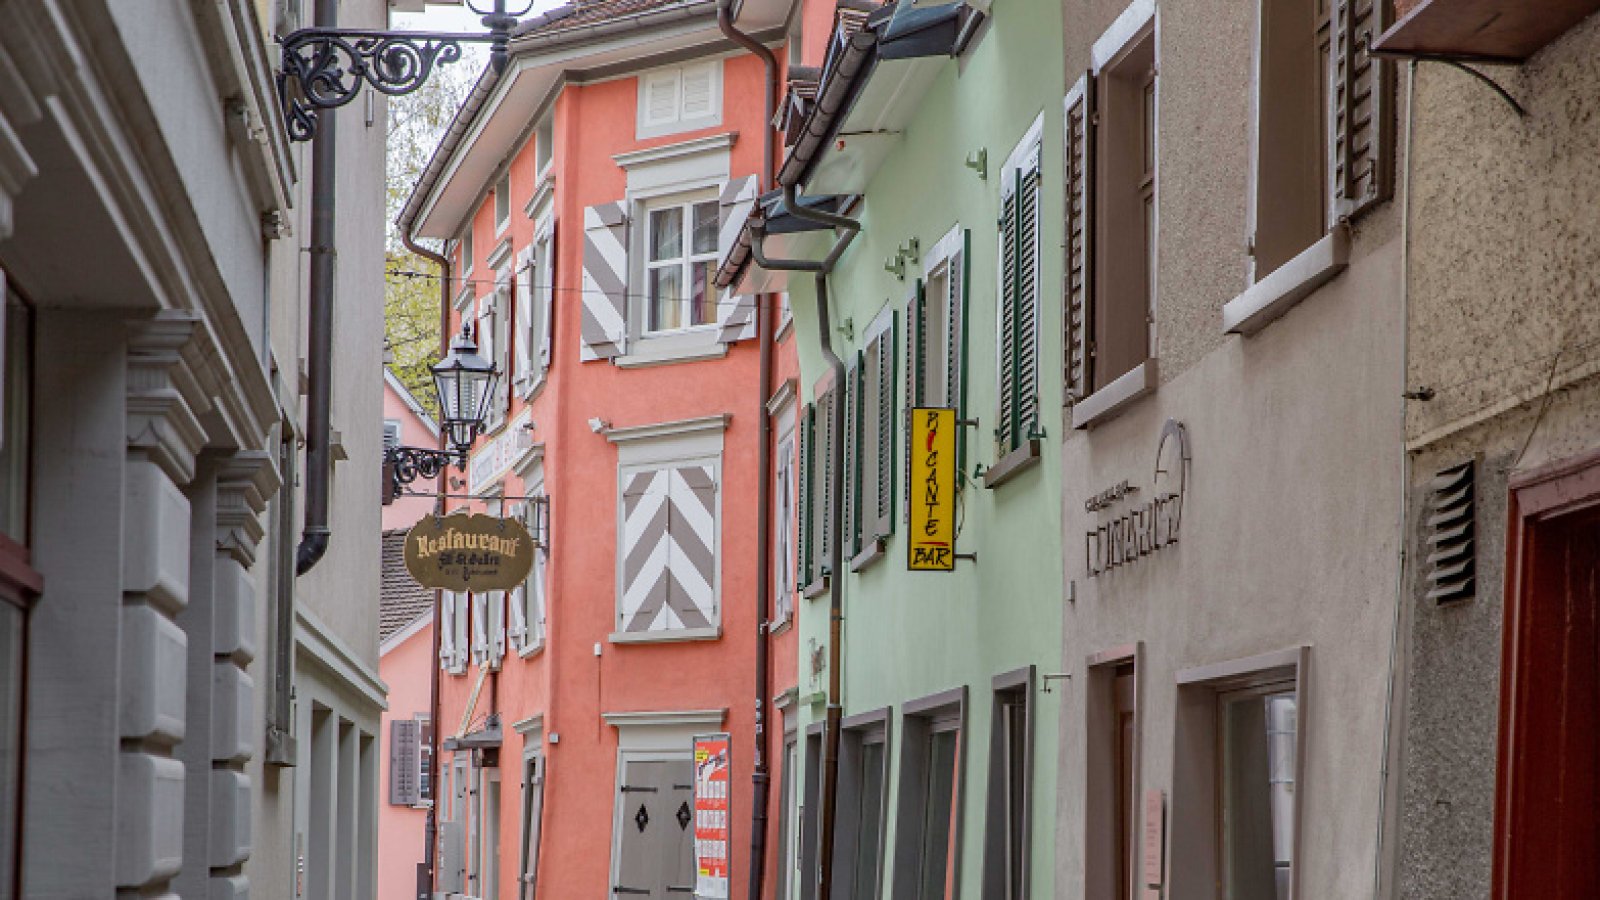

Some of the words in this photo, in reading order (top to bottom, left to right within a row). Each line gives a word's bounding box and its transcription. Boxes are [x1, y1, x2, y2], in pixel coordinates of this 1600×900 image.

[925, 411, 939, 536] PICANTE
[417, 527, 520, 559] Restaurant
[912, 547, 951, 567] BAR
